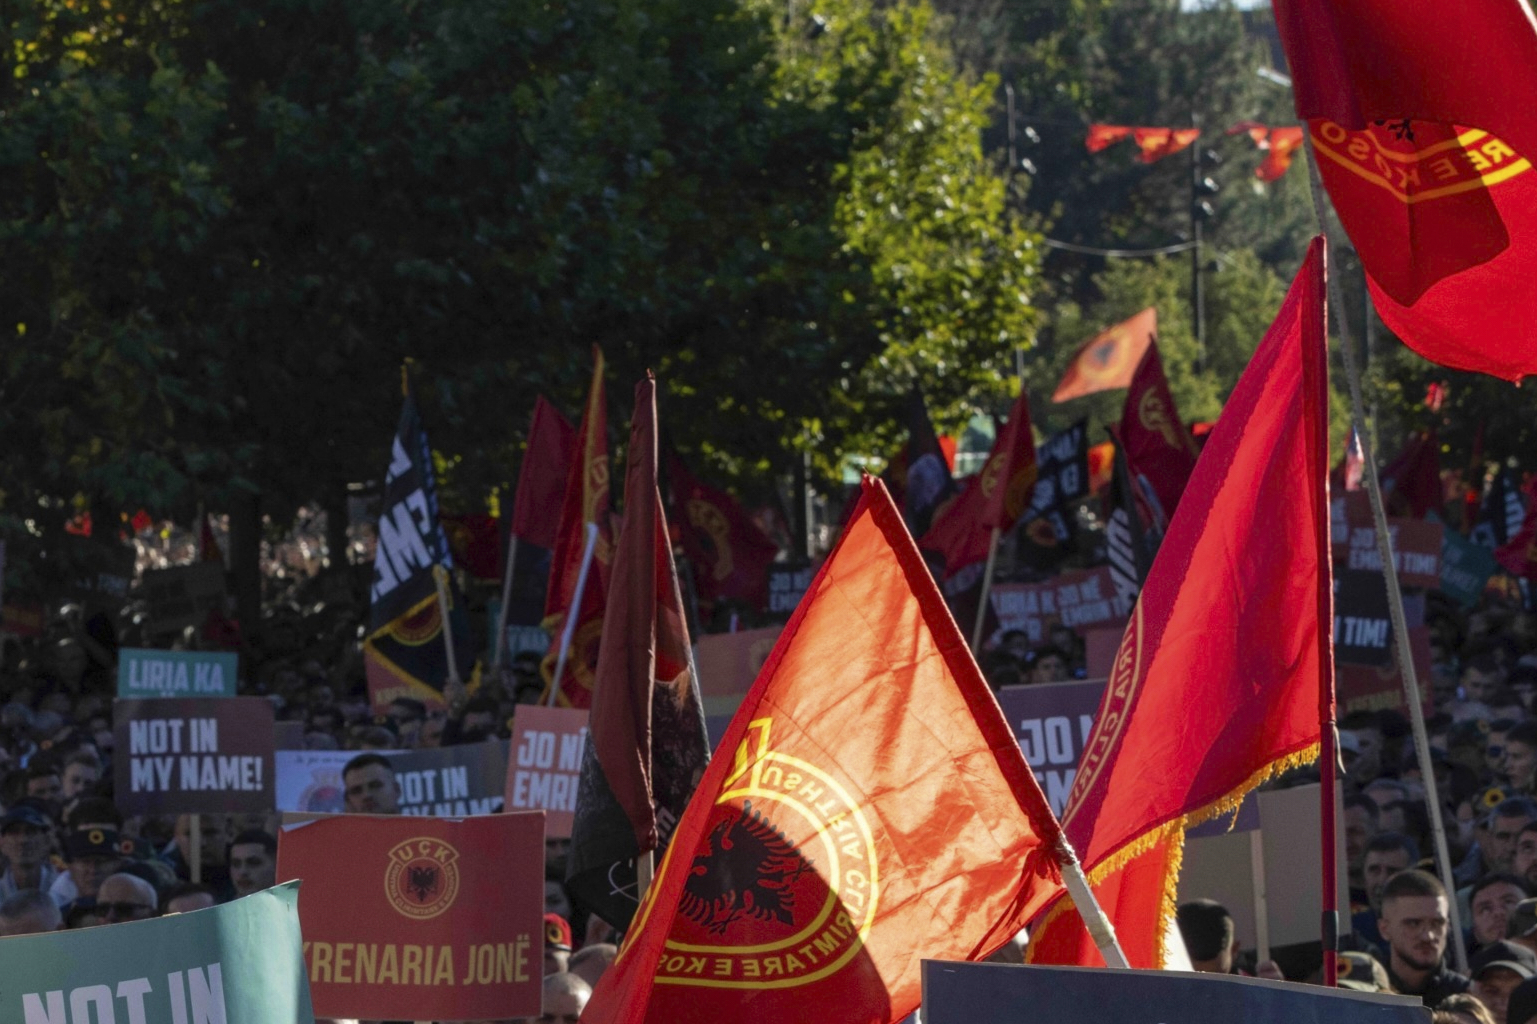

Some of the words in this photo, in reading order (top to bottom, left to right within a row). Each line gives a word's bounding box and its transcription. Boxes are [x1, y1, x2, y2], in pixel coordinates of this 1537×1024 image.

[1403, 553, 1438, 575] TIM!
[1344, 616, 1389, 648] TIM!
[129, 658, 189, 692] LIRIA
[194, 662, 225, 692] KA
[129, 719, 184, 756] NOT
[190, 718, 218, 754] IN
[517, 730, 556, 769] JO
[1019, 716, 1075, 767] JO
[131, 757, 172, 793] MY
[180, 756, 264, 793] NAME!
[441, 765, 469, 799] IN
[398, 840, 451, 863] UÇK
[463, 933, 531, 985] JONË
